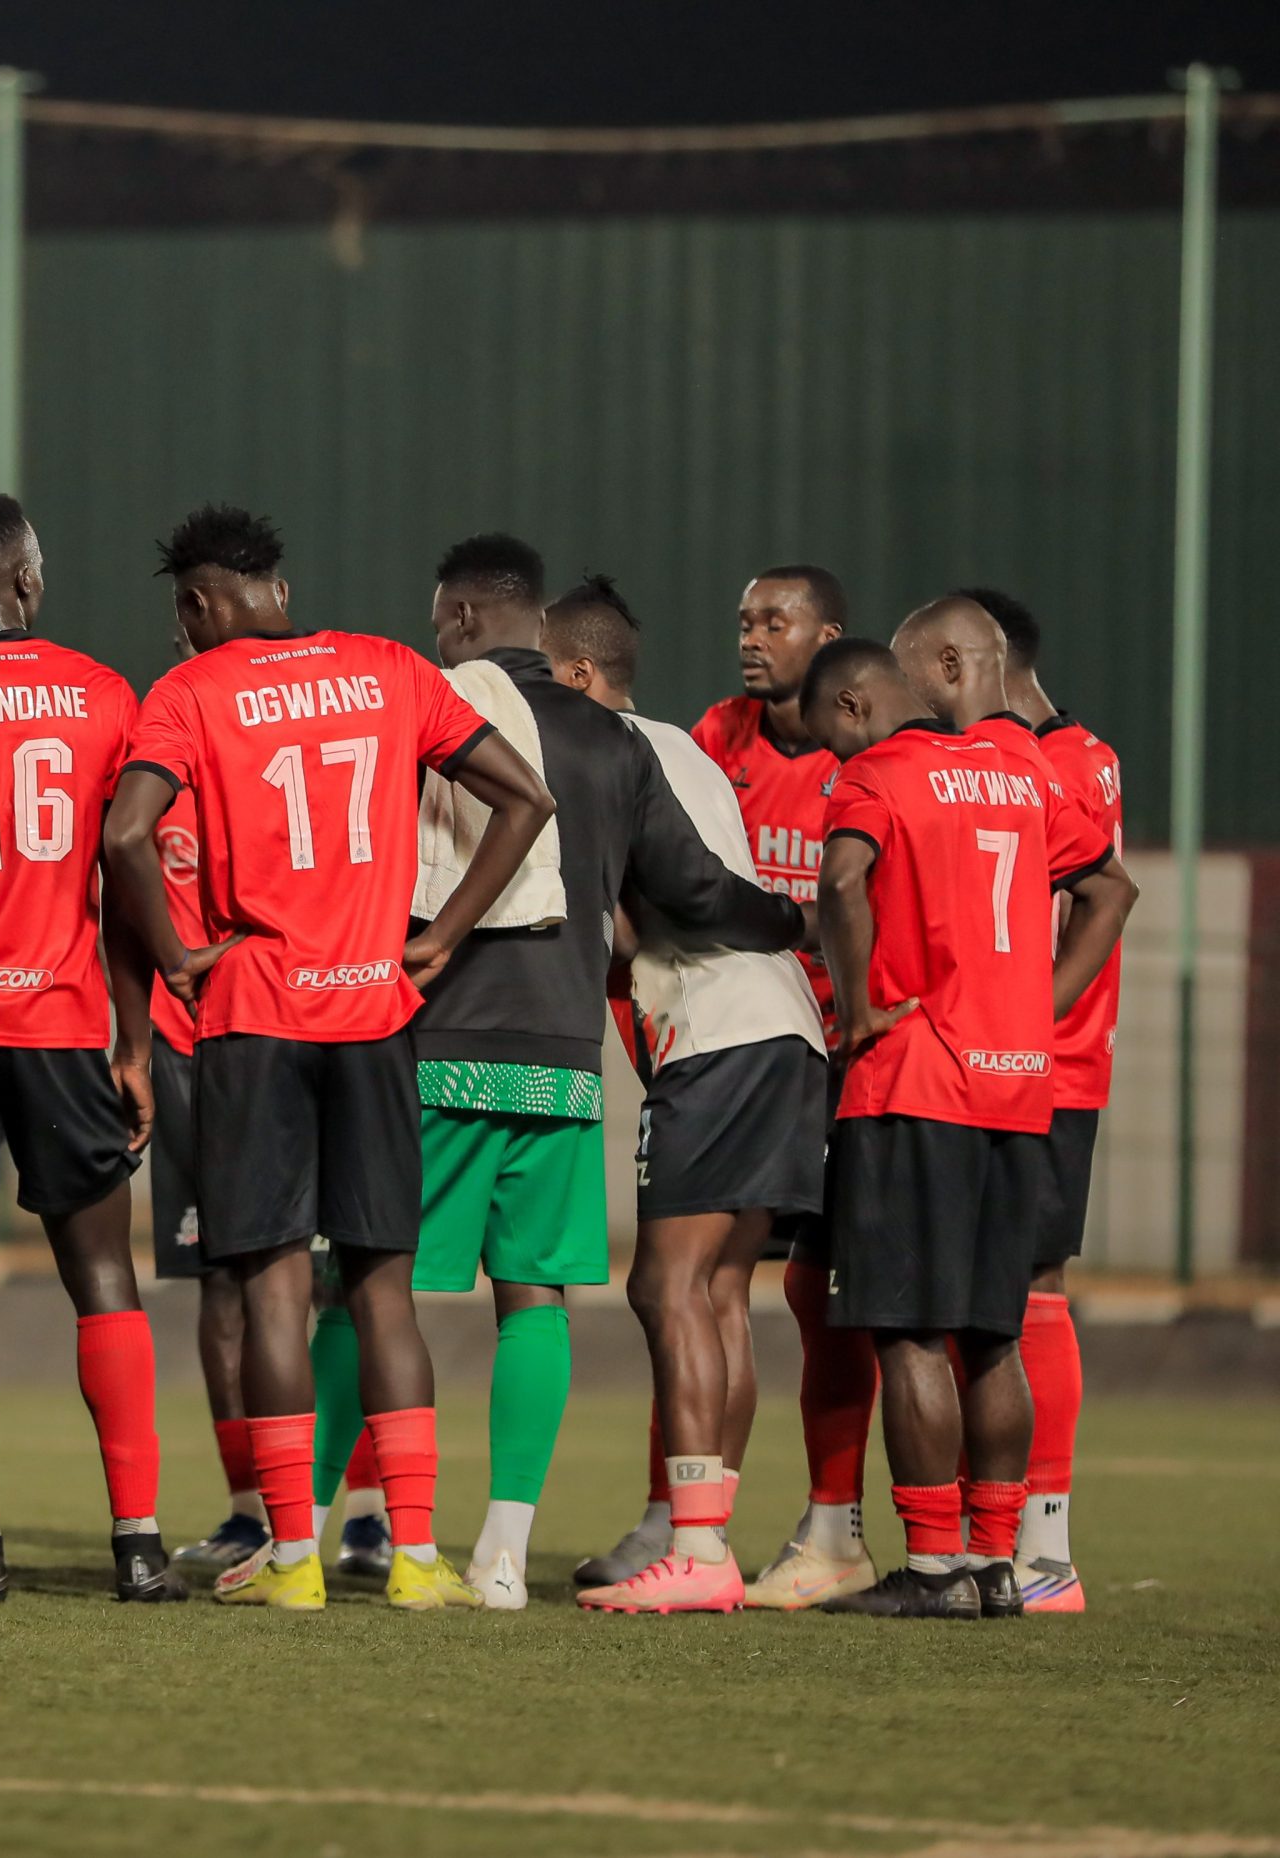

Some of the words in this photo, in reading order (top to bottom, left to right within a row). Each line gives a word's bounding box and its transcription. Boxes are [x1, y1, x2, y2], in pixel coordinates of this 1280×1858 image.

[7, 653, 39, 661] DREAM
[267, 651, 291, 662] TEAM
[235, 675, 385, 728] OGWANG
[261, 735, 379, 870] 17
[975, 828, 1019, 953] 7
[296, 961, 392, 987] PLASCON
[969, 1053, 1046, 1073] PLASCON
[680, 1464, 703, 1478] 17
